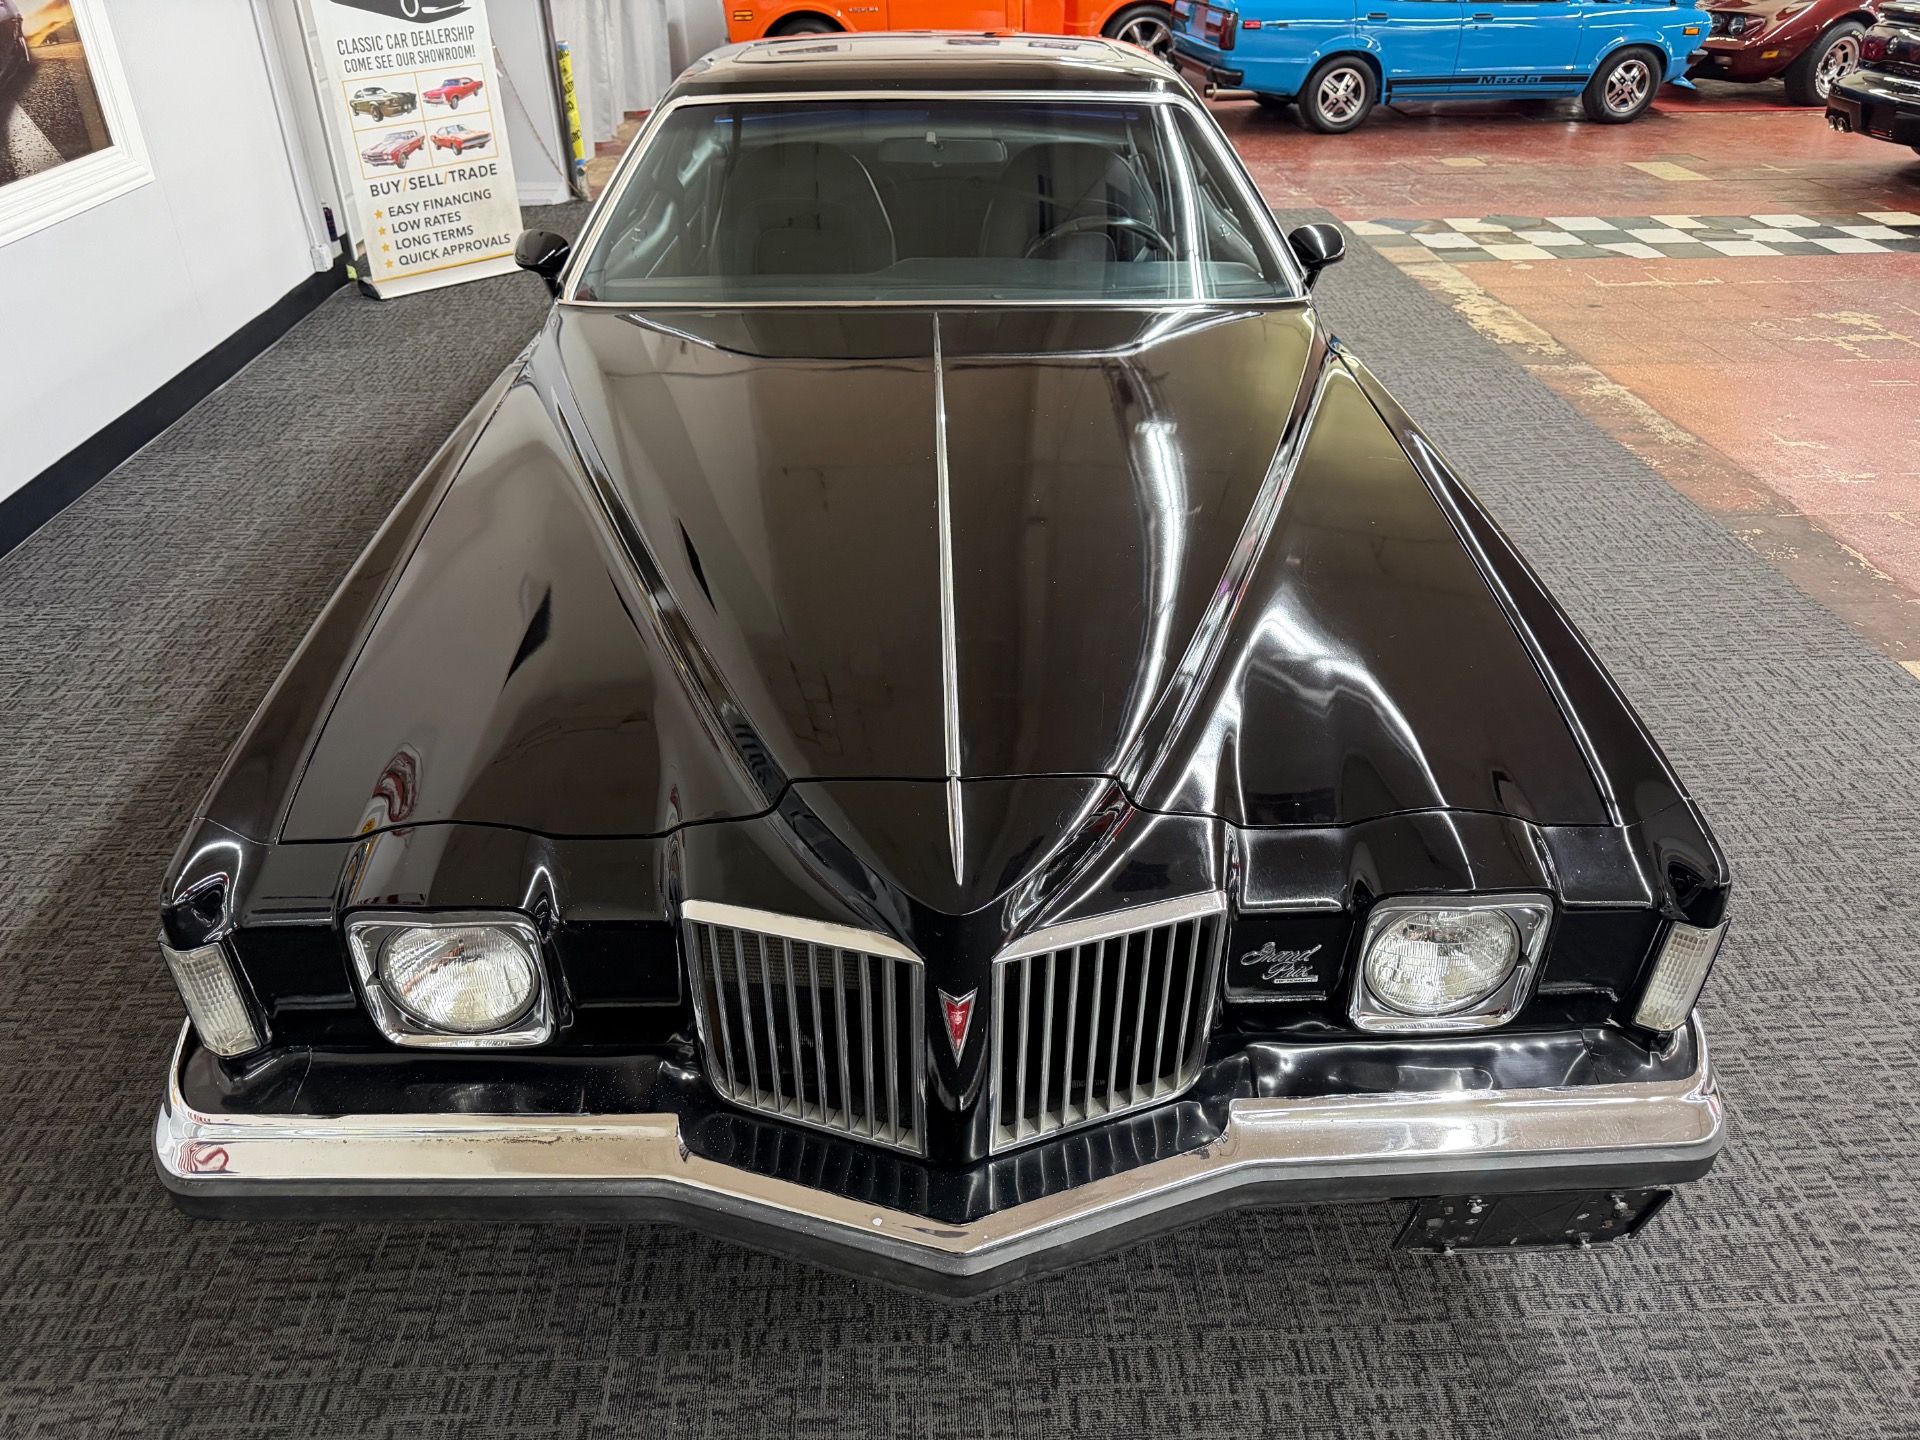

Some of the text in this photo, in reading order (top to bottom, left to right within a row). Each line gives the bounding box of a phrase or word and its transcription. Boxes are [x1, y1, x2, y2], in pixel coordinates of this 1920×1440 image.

[337, 25, 475, 55] CLASSIC CAR DEALERSHIP
[344, 44, 476, 73] COME SEE OUR SHOWROOM!
[1478, 75, 1542, 85] Mazda
[388, 188, 492, 217] EASY FINANCING
[391, 211, 462, 234] LOW RATES
[395, 225, 474, 250] LONG TERMS
[399, 233, 511, 266] QUICK APPROVALS
[1240, 941, 1322, 965] Grand
[1262, 961, 1313, 980] Prix
